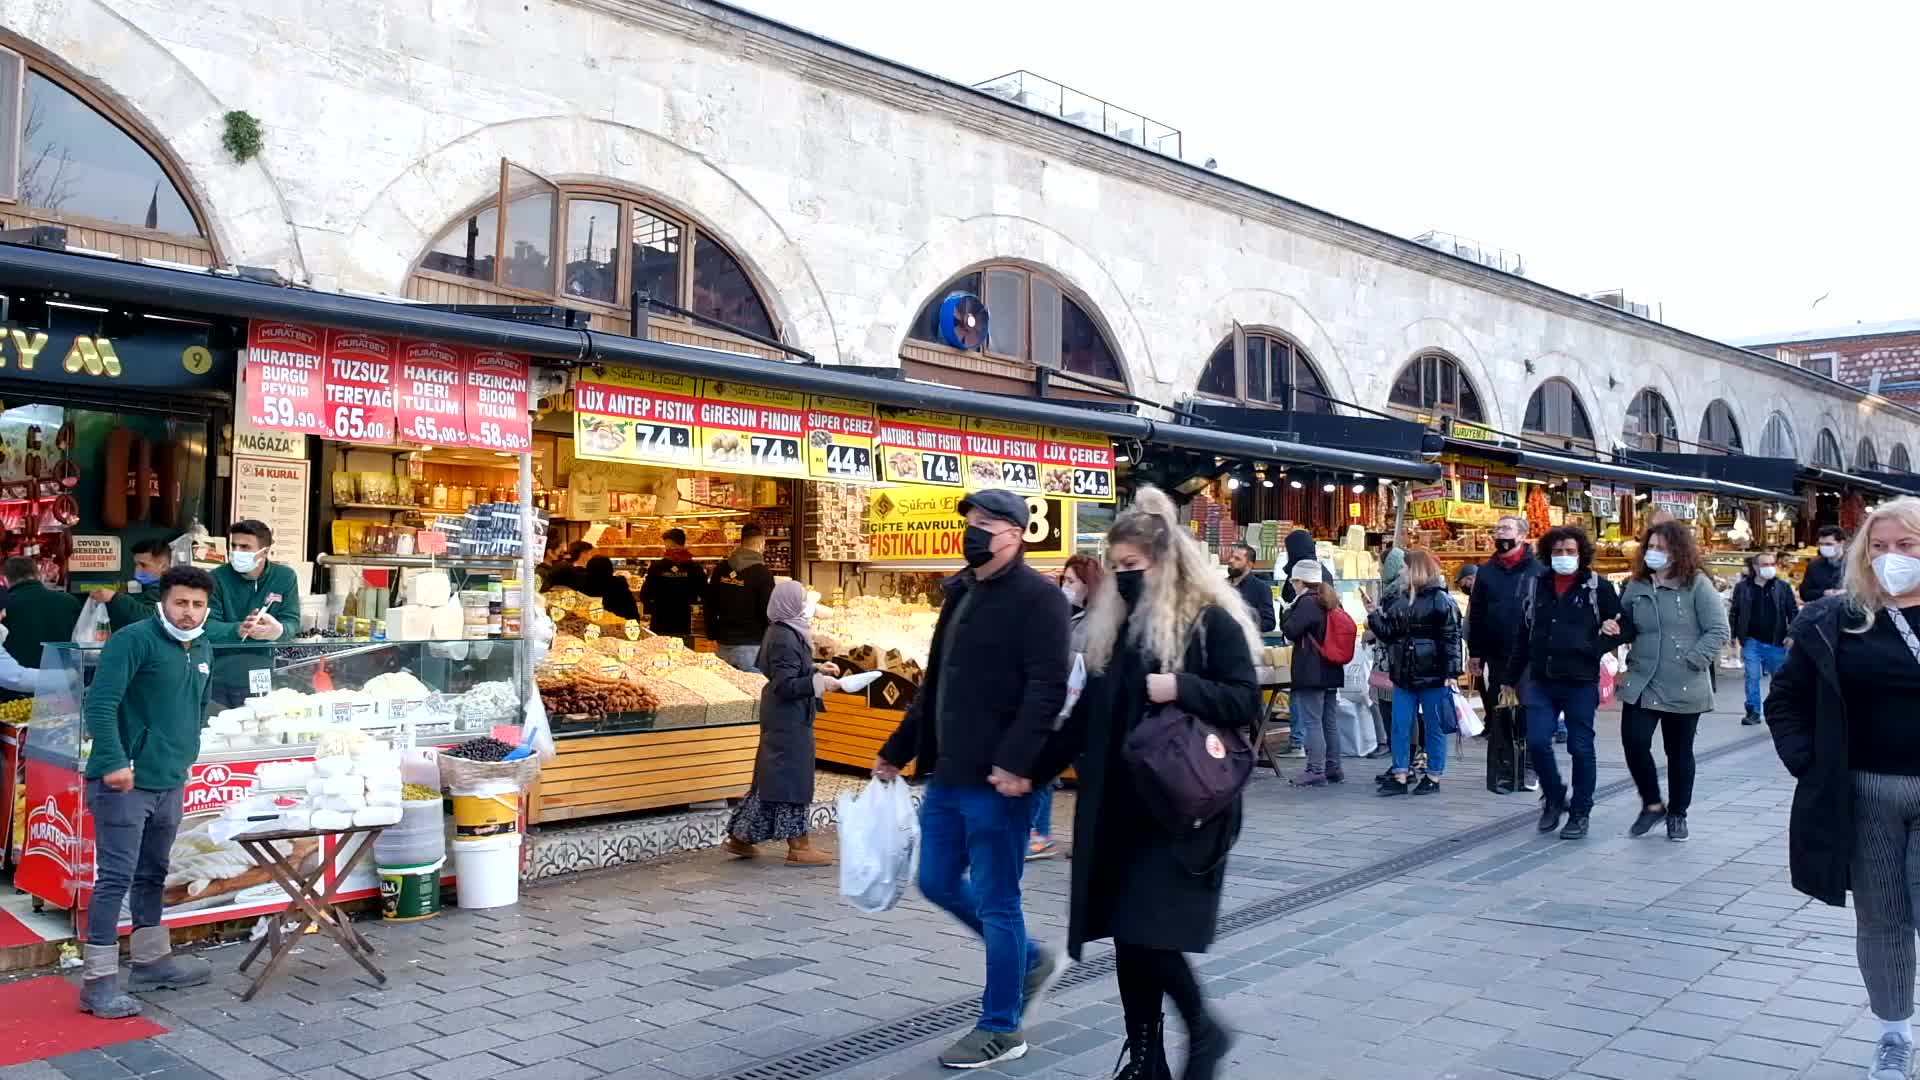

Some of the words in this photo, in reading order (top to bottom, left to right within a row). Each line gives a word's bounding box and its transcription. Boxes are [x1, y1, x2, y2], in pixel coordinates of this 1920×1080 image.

[262, 328, 313, 343] MURATBEY
[337, 339, 386, 353] MURATBEY
[191, 351, 203, 369] 9
[250, 347, 321, 370] MURATBEY
[409, 349, 455, 362] MURATBEY
[476, 357, 519, 370] MURATBEY
[262, 365, 309, 385] BURGU
[332, 358, 390, 384] TUZSUZ
[263, 396, 316, 428] 59.90
[402, 395, 459, 415] TULUM
[476, 402, 517, 419] TULUM
[579, 386, 605, 411] LÜX
[608, 392, 651, 417] ANTEP
[654, 400, 694, 422] FISTIK
[334, 406, 384, 439] 65.00
[760, 411, 802, 433] FINDIK
[808, 411, 840, 430] SÜPER
[843, 418, 873, 435] ÇEREZ
[881, 426, 916, 446] NATUREL
[939, 434, 962, 452] FISTIK
[967, 436, 1000, 454] TUZLU
[1003, 439, 1037, 459] FISTIK
[828, 447, 870, 477] 44.90
[1043, 442, 1066, 460] LÜX
[1069, 447, 1109, 465] ÇEREZ
[255, 468, 264, 477] 14
[267, 469, 299, 480] KURAL
[922, 454, 959, 482] 74.90
[897, 498, 936, 516] Şükrü
[1421, 500, 1437, 514] 48
[907, 519, 968, 532] KAVRULM
[870, 533, 927, 556] FISTIKLI
[932, 532, 964, 555] LOK
[184, 786, 252, 808] URATBE
